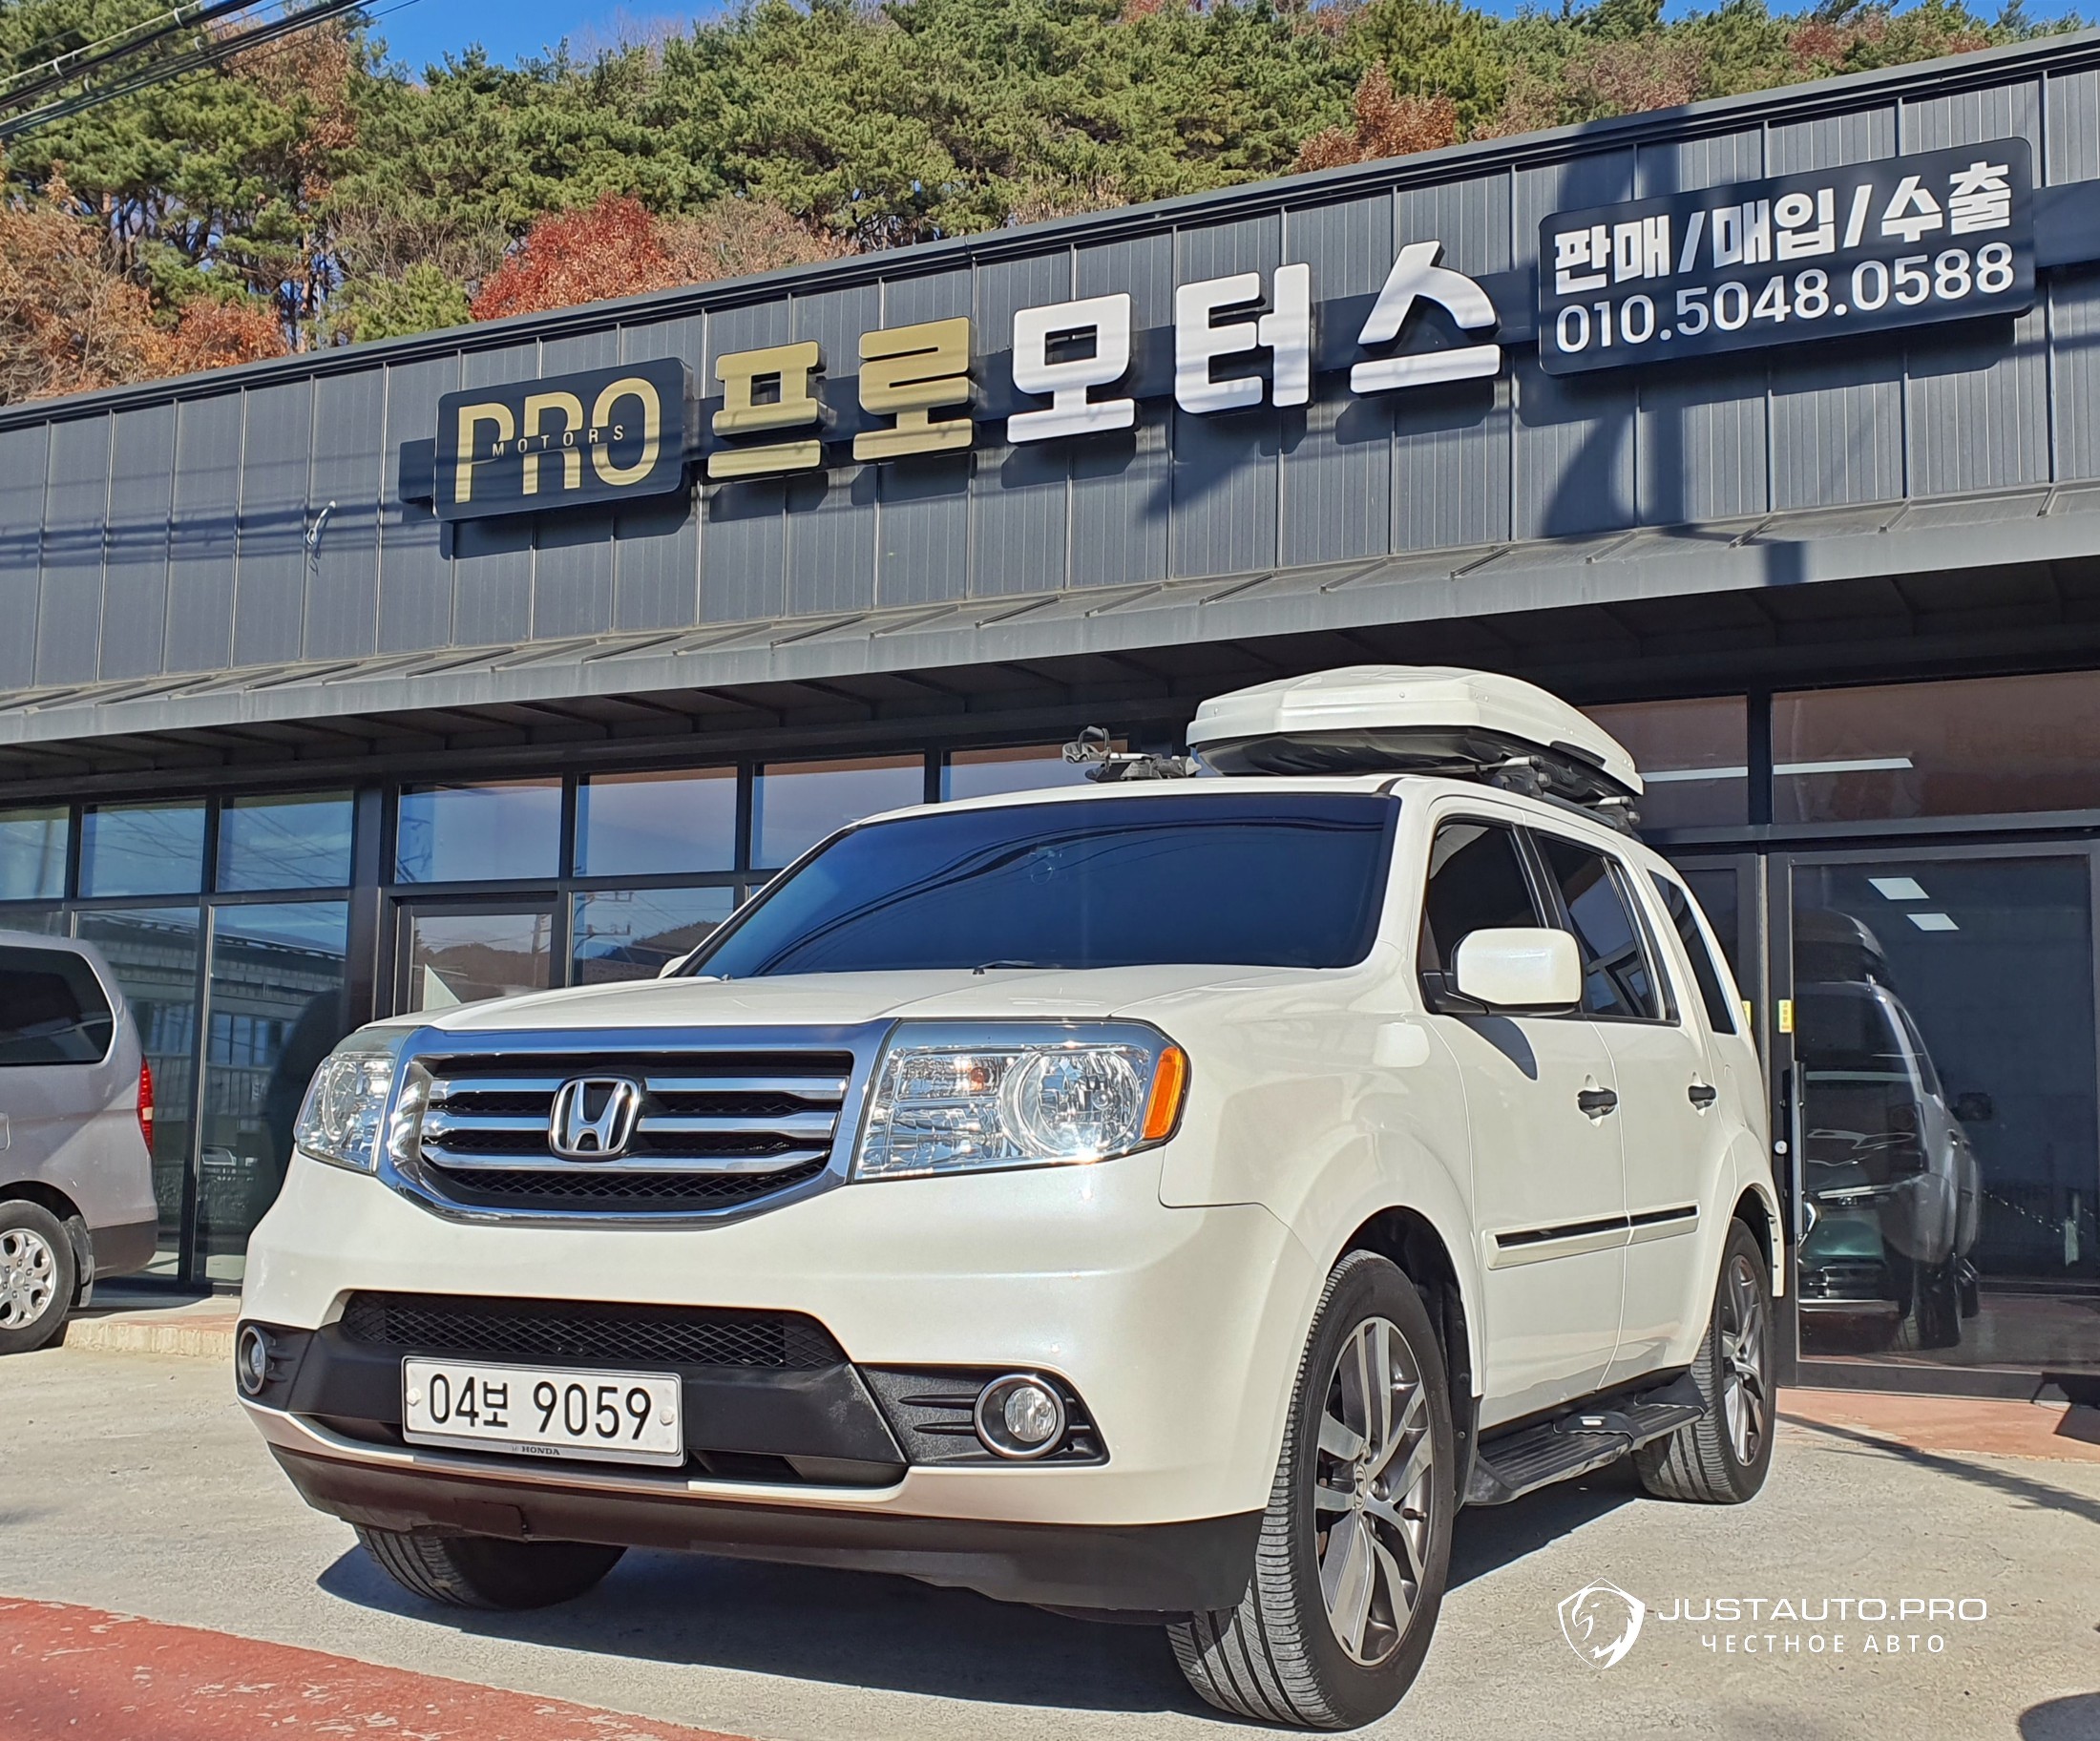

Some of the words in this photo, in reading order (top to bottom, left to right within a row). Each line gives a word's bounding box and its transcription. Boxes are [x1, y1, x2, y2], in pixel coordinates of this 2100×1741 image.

[1554, 160, 2012, 296] 판매/매입/수출
[1555, 241, 2015, 354] 010.5048.0588
[707, 241, 1502, 479] 프로모터스
[454, 377, 662, 505] PRO
[492, 425, 624, 458] MOTORS
[430, 1373, 509, 1429] 04보
[534, 1380, 652, 1441] 9059
[521, 1445, 561, 1457] HONDA
